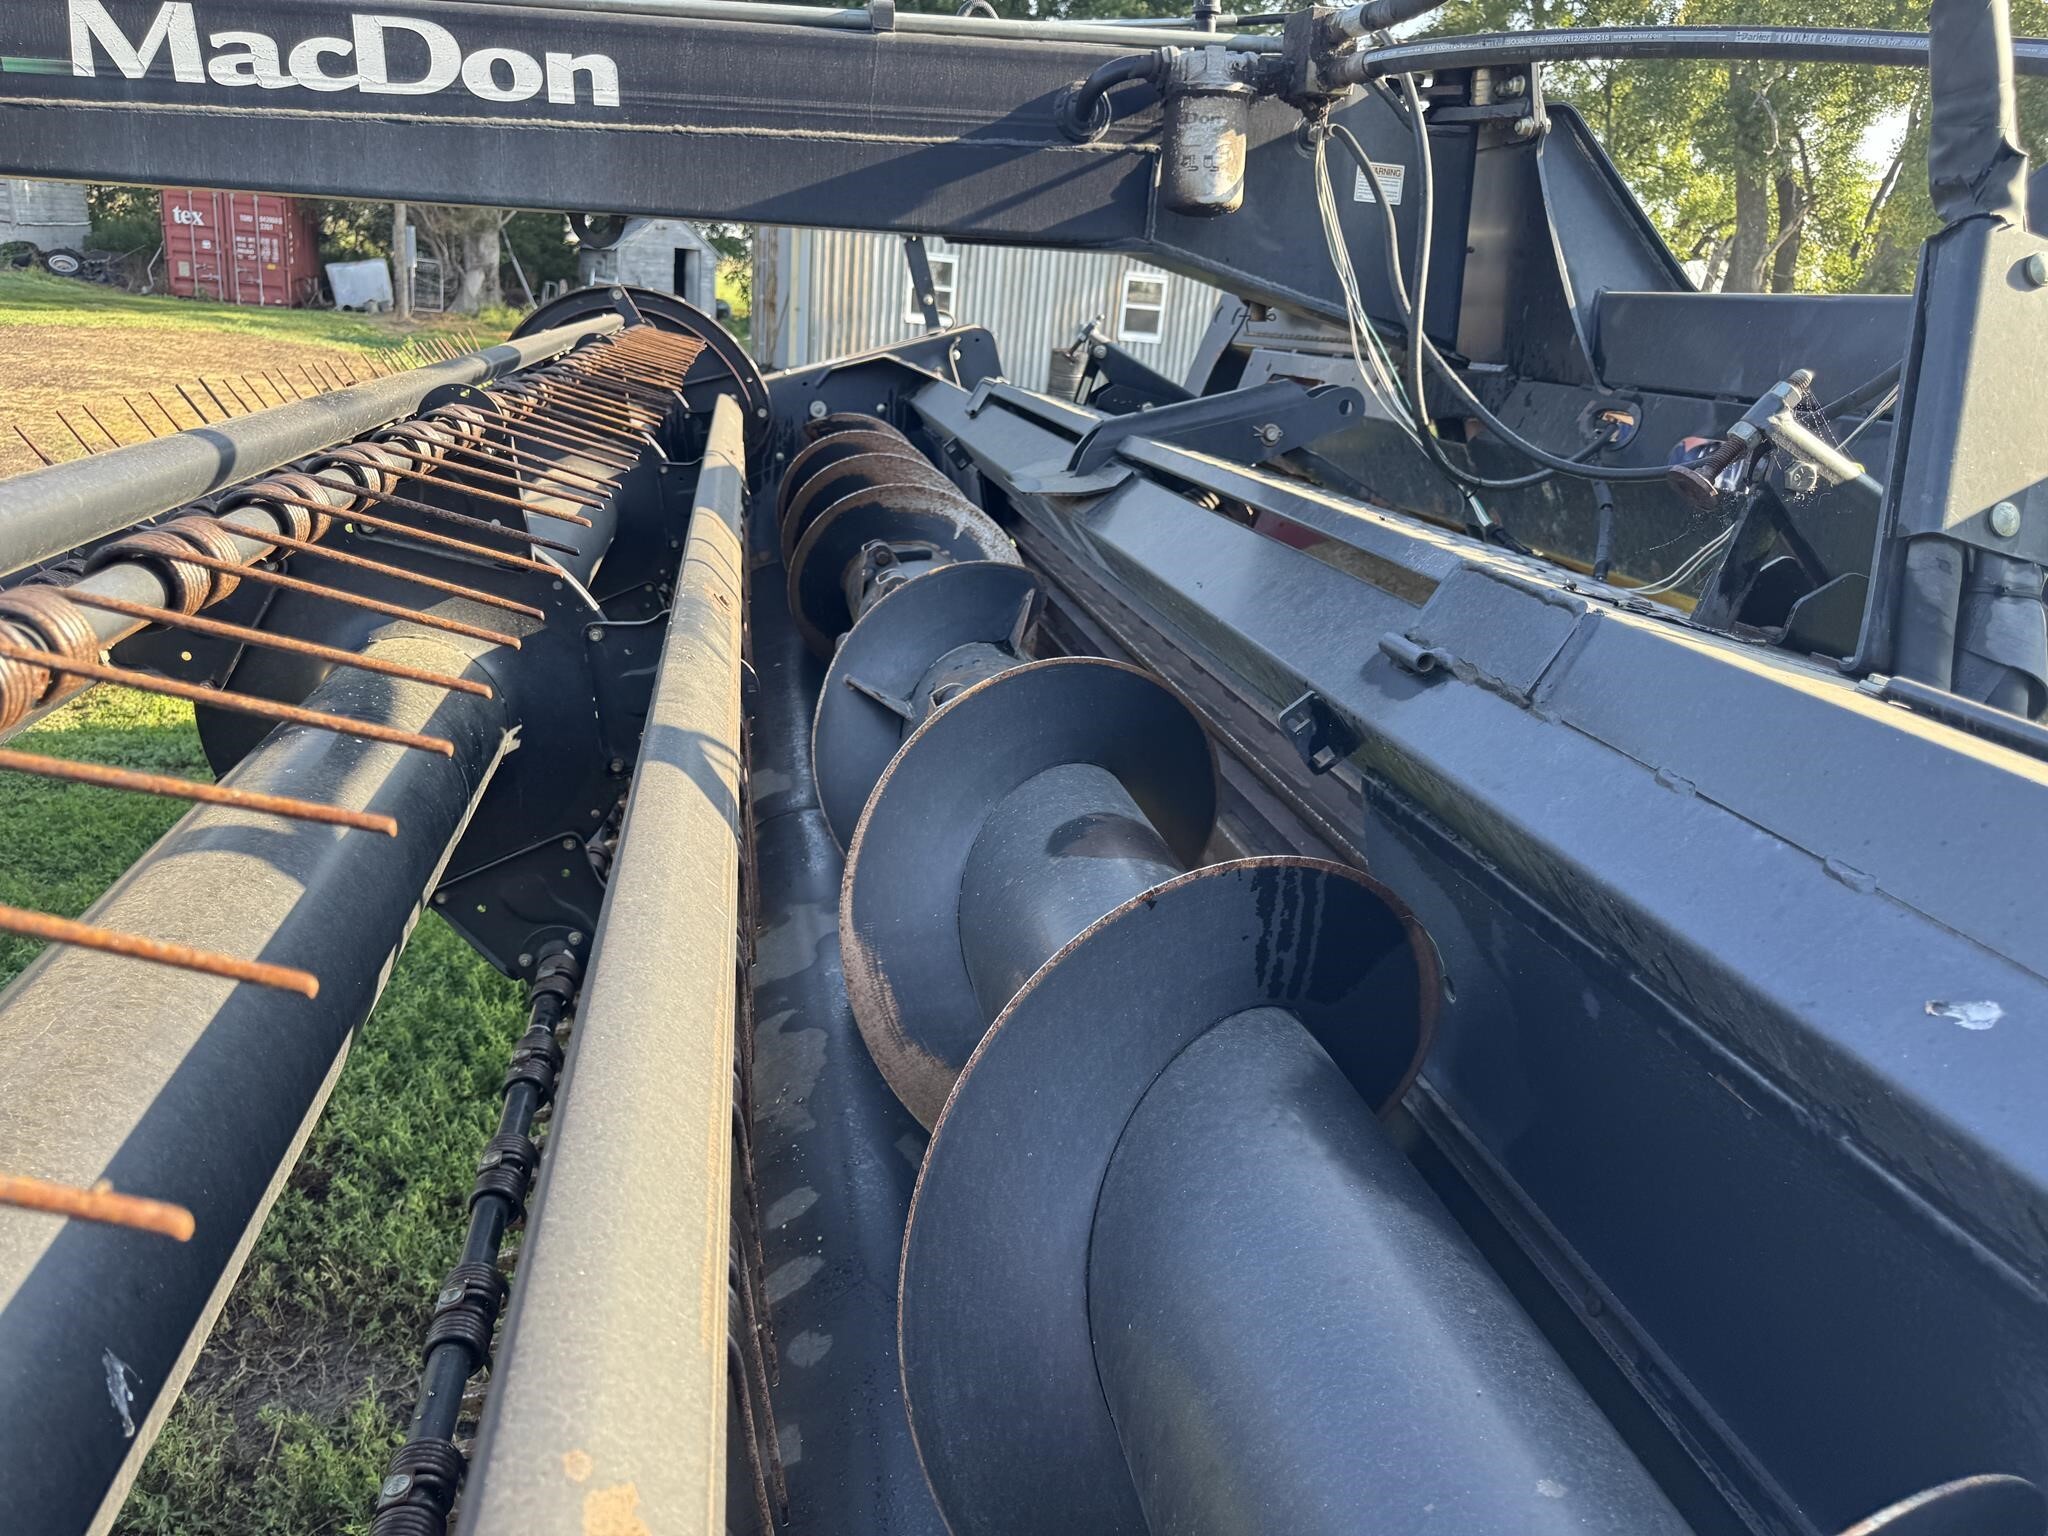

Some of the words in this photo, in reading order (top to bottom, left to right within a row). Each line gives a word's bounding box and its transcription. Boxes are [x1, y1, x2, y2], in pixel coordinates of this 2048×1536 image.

[1740, 32, 1771, 42] Parker
[68, 0, 620, 107] MacDon
[1373, 167, 1401, 177] ARNING
[172, 205, 205, 226] tex
